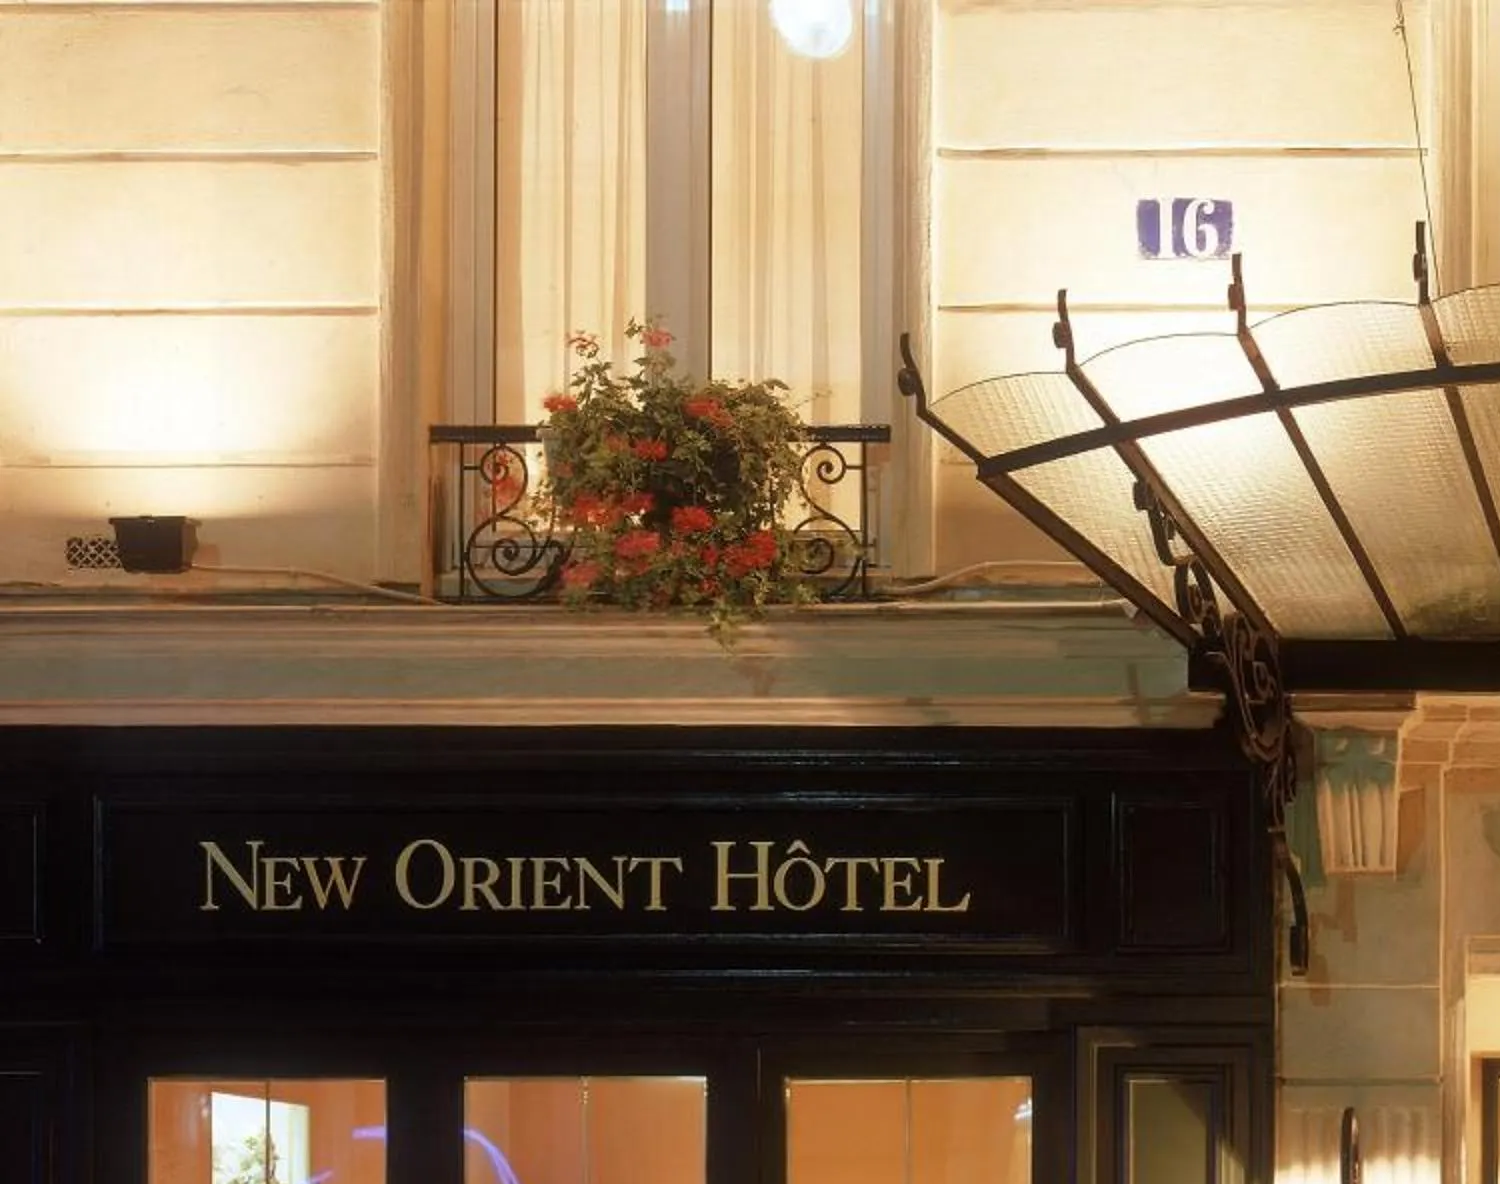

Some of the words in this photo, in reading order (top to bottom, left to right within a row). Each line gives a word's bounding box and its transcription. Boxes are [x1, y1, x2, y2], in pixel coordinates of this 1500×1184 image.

[1154, 198, 1220, 259] 16
[199, 840, 368, 910] NEW
[395, 839, 683, 911] ORIENT
[709, 839, 971, 912] HÔTEL
